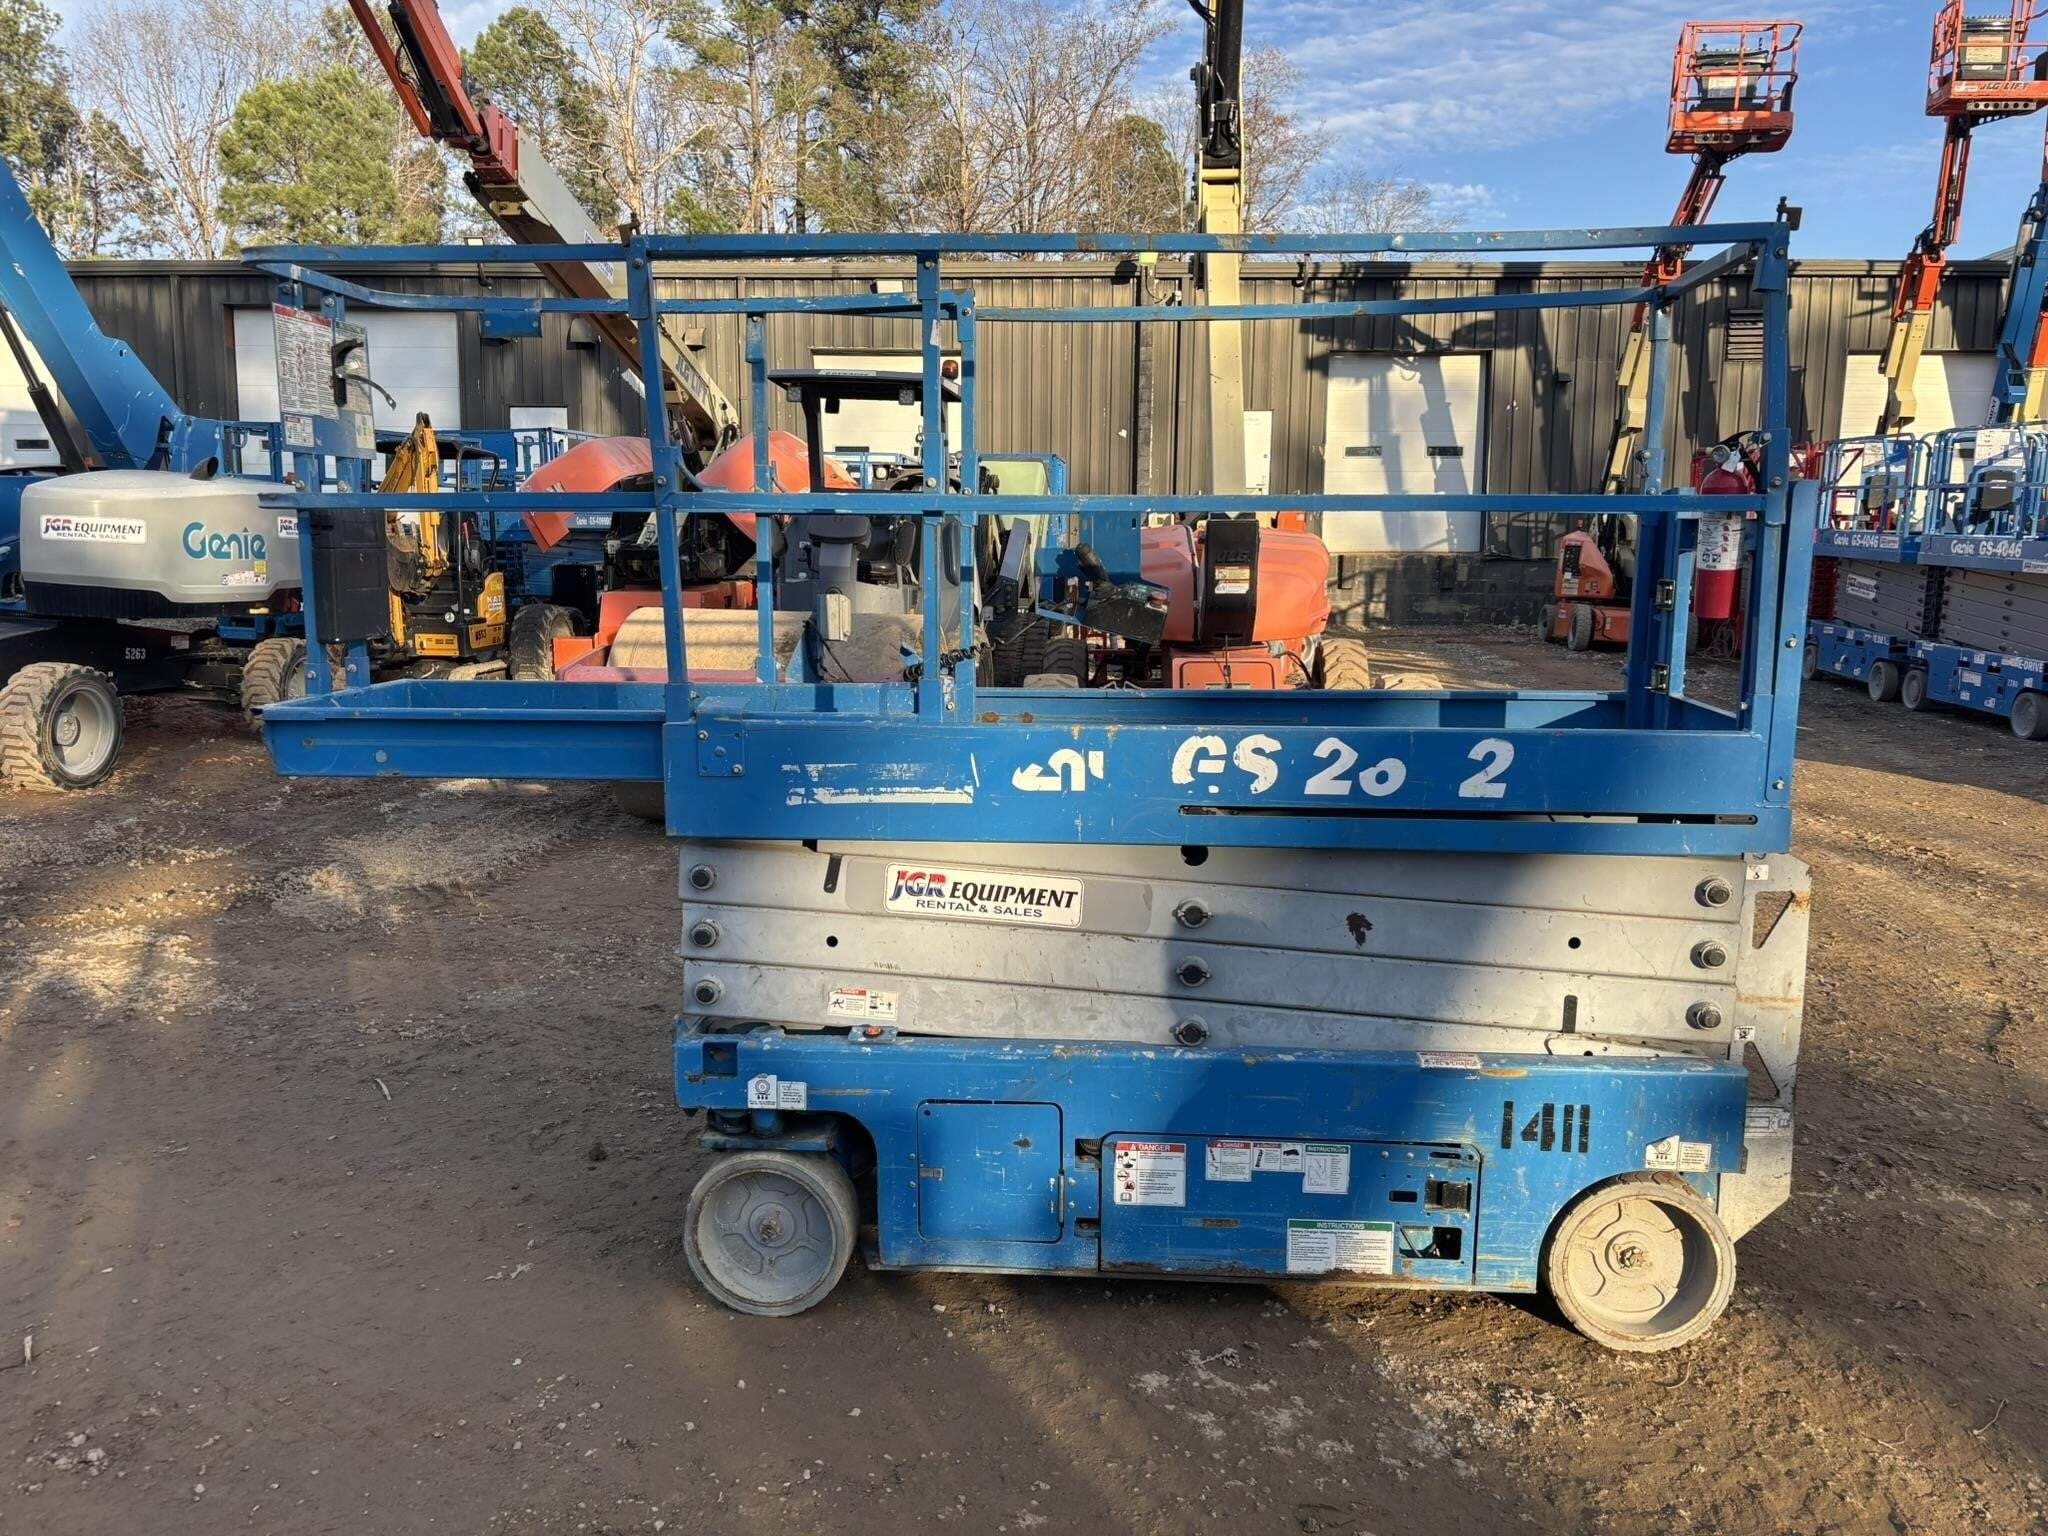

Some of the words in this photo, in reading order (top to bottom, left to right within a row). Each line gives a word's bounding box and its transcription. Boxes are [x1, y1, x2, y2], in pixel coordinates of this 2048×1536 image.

[1980, 82, 2001, 90] JLG
[2004, 82, 2029, 90] LIFT
[43, 518, 73, 534] JGR
[74, 522, 144, 534] EQUIPMENT
[182, 521, 267, 560] Genie
[1950, 540, 1974, 555] Genie
[1979, 540, 2022, 558] GS-4046
[125, 647, 147, 660] 5263
[889, 870, 946, 901] JGR
[949, 881, 1079, 909] EQUIPMENT
[916, 899, 974, 913] RENTAL
[978, 904, 988, 914] &
[993, 905, 1043, 919] SALES
[1501, 1100, 1591, 1154] 1411
[1138, 1144, 1171, 1152] DANGER
[1316, 1222, 1366, 1231] INSTRUCTIONS
